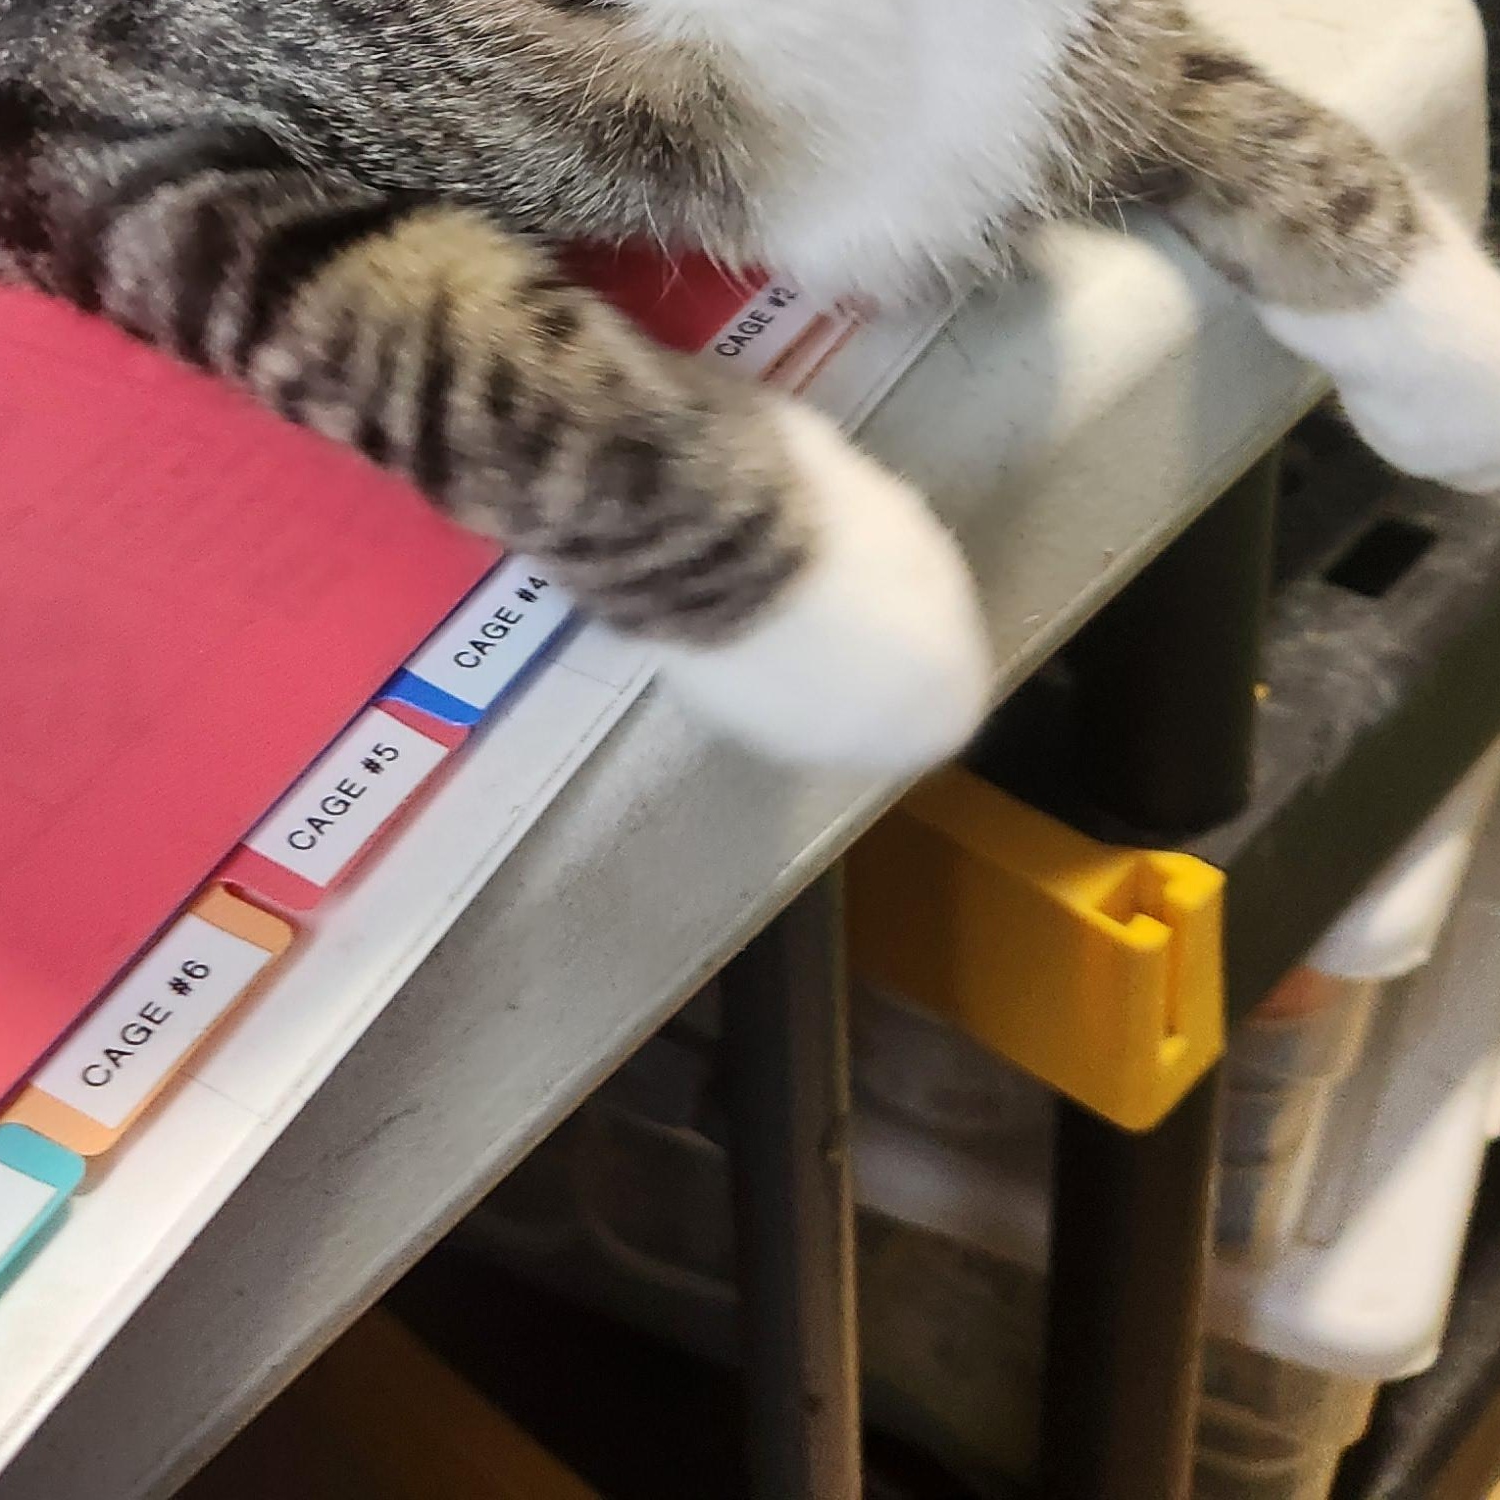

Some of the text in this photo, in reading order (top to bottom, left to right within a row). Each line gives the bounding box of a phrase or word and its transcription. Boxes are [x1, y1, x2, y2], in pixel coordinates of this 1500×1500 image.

[713, 309, 775, 356] CAGE
[453, 575, 549, 668] CAGE #4
[287, 742, 399, 850] CAGE #5
[81, 959, 210, 1086] CAGE #6
